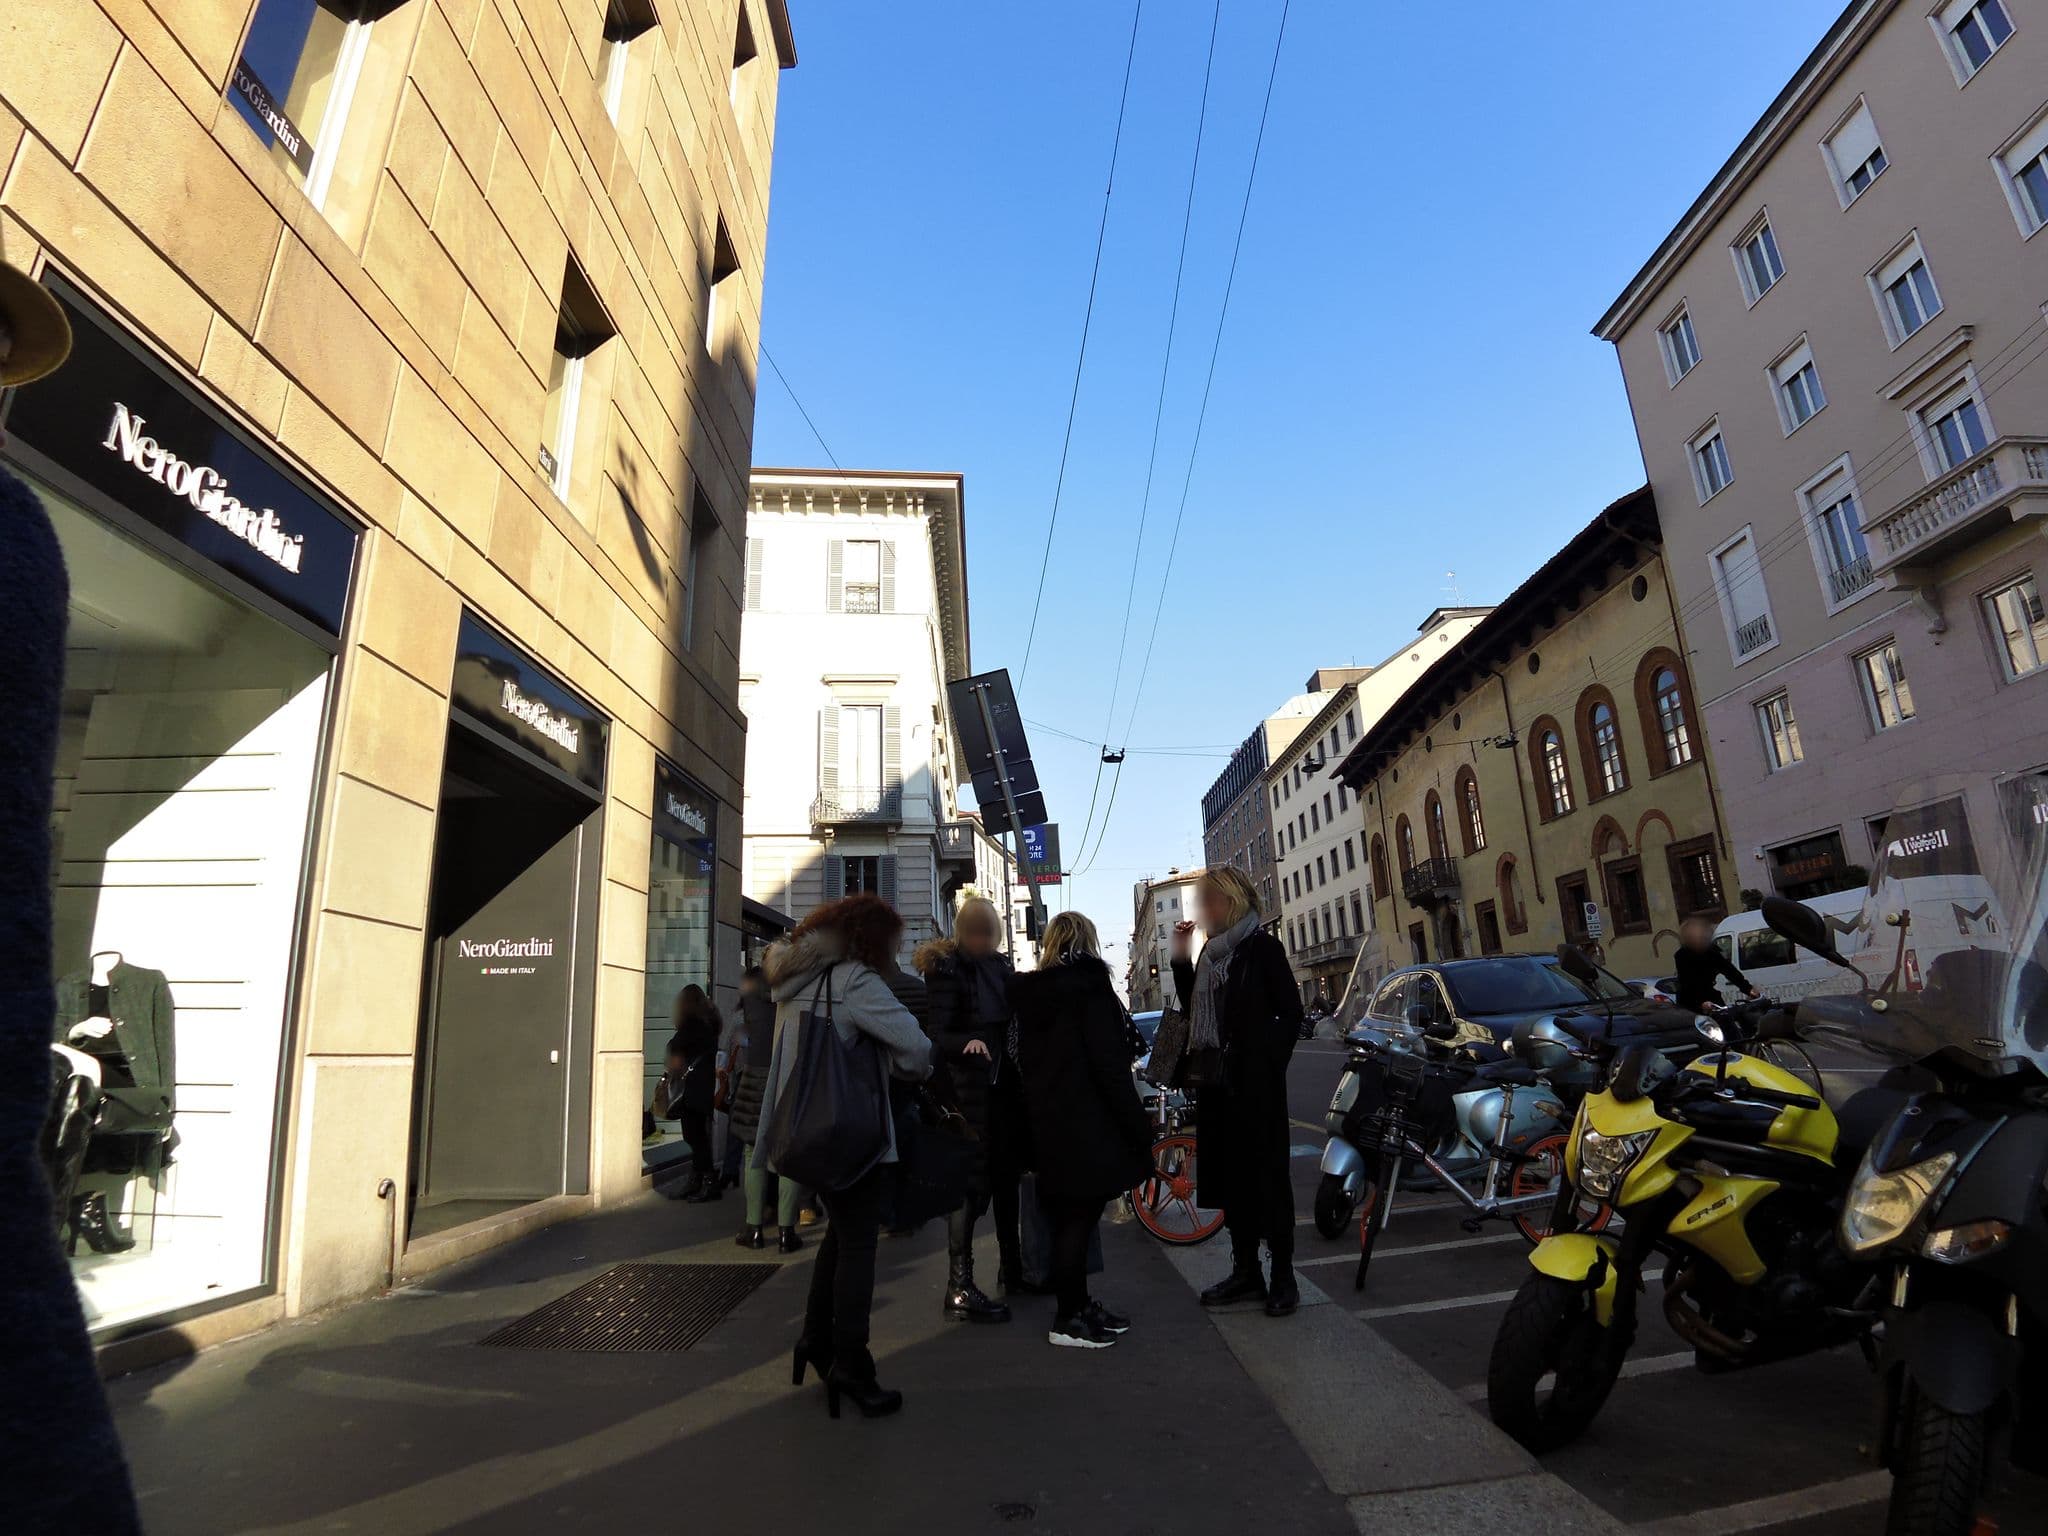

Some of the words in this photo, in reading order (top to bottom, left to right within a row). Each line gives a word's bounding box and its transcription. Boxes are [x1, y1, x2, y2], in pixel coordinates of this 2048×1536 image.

[102, 402, 304, 574] NeroGiardini
[501, 679, 578, 753] NeroGiardini
[666, 792, 706, 835] NeroGiardini
[1018, 874, 1061, 884] COPLETO
[458, 937, 554, 958] NeroGiardini
[490, 967, 509, 975] MADE
